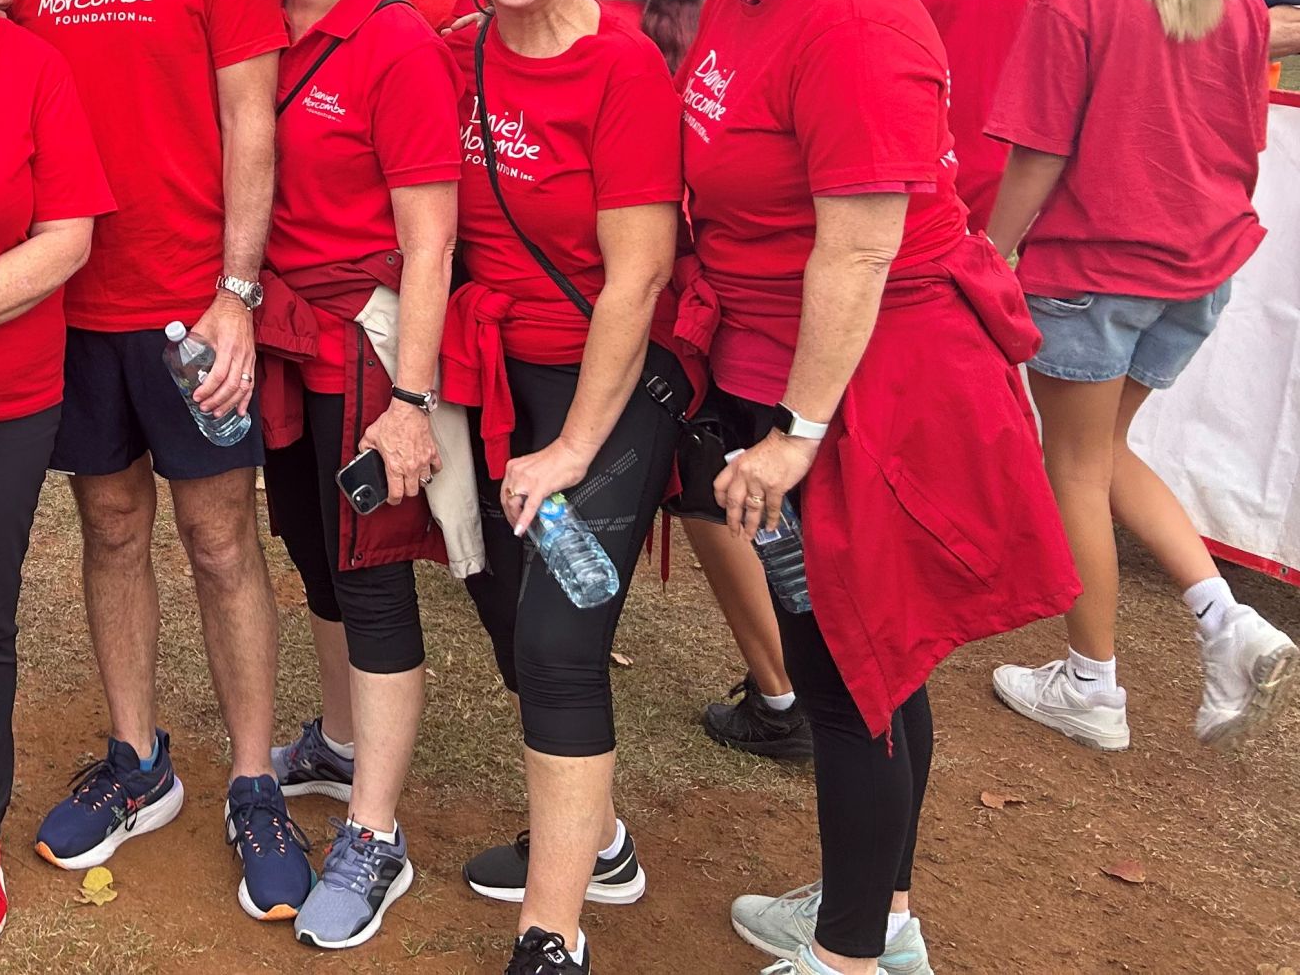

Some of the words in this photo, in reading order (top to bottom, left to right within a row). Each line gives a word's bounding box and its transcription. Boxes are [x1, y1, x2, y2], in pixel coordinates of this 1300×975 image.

[55, 12, 135, 25] FOUNDATION
[138, 14, 156, 22] Inc.
[695, 49, 736, 98] Daniel
[309, 85, 339, 104] Daniel
[302, 97, 346, 115] Morcombe
